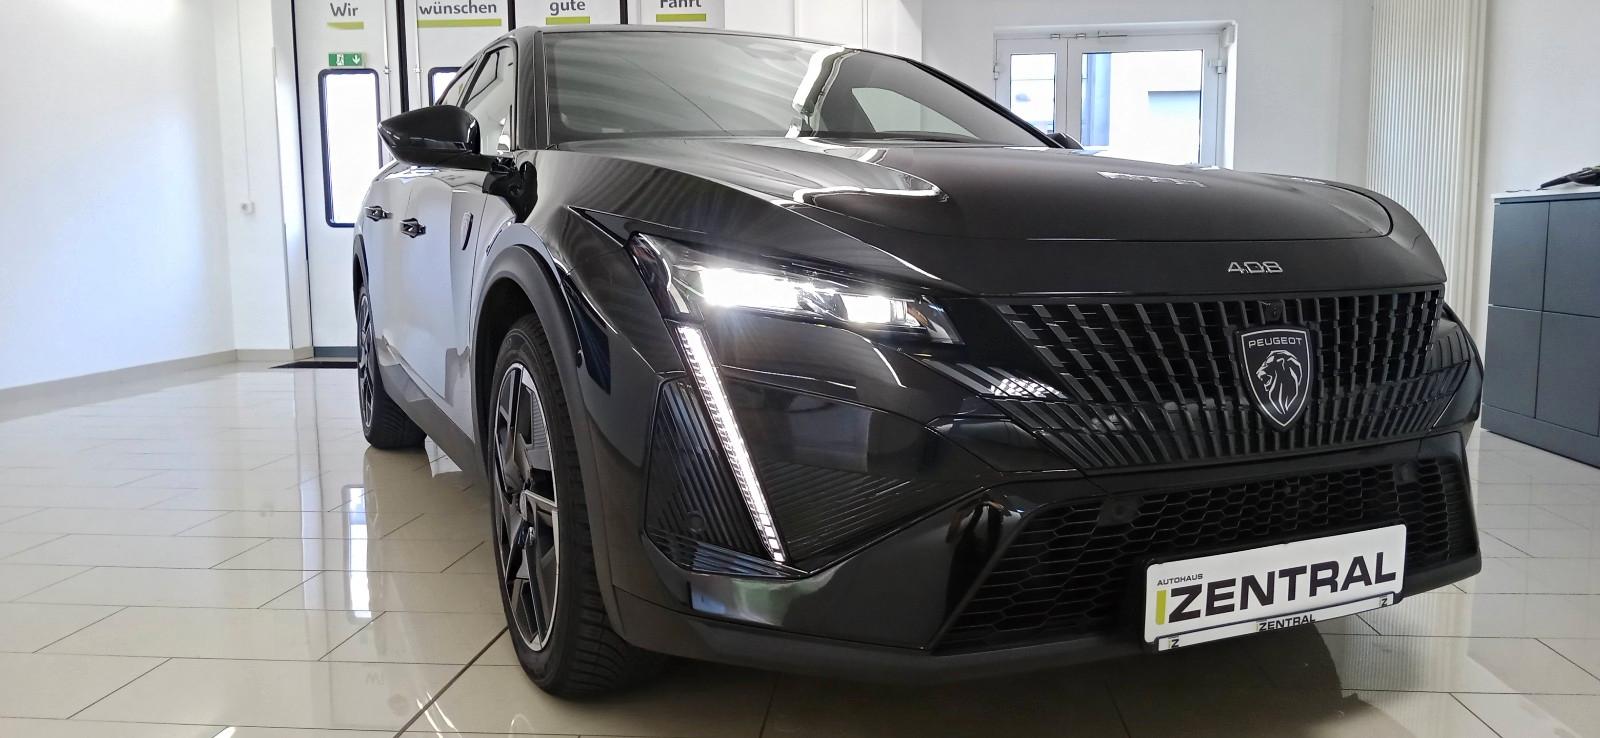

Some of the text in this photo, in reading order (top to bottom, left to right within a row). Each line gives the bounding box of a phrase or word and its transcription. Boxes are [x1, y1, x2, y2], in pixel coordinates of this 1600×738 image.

[329, 3, 359, 17] Wir
[419, 1, 498, 15] wünschen
[549, 0, 586, 16] gute
[1228, 261, 1283, 273] 408
[1248, 337, 1302, 348] PEUGEOT
[1157, 573, 1204, 586] AUTOHAUS
[1168, 552, 1397, 624] ZENTRAL
[1259, 614, 1316, 631] ZENTRAL
